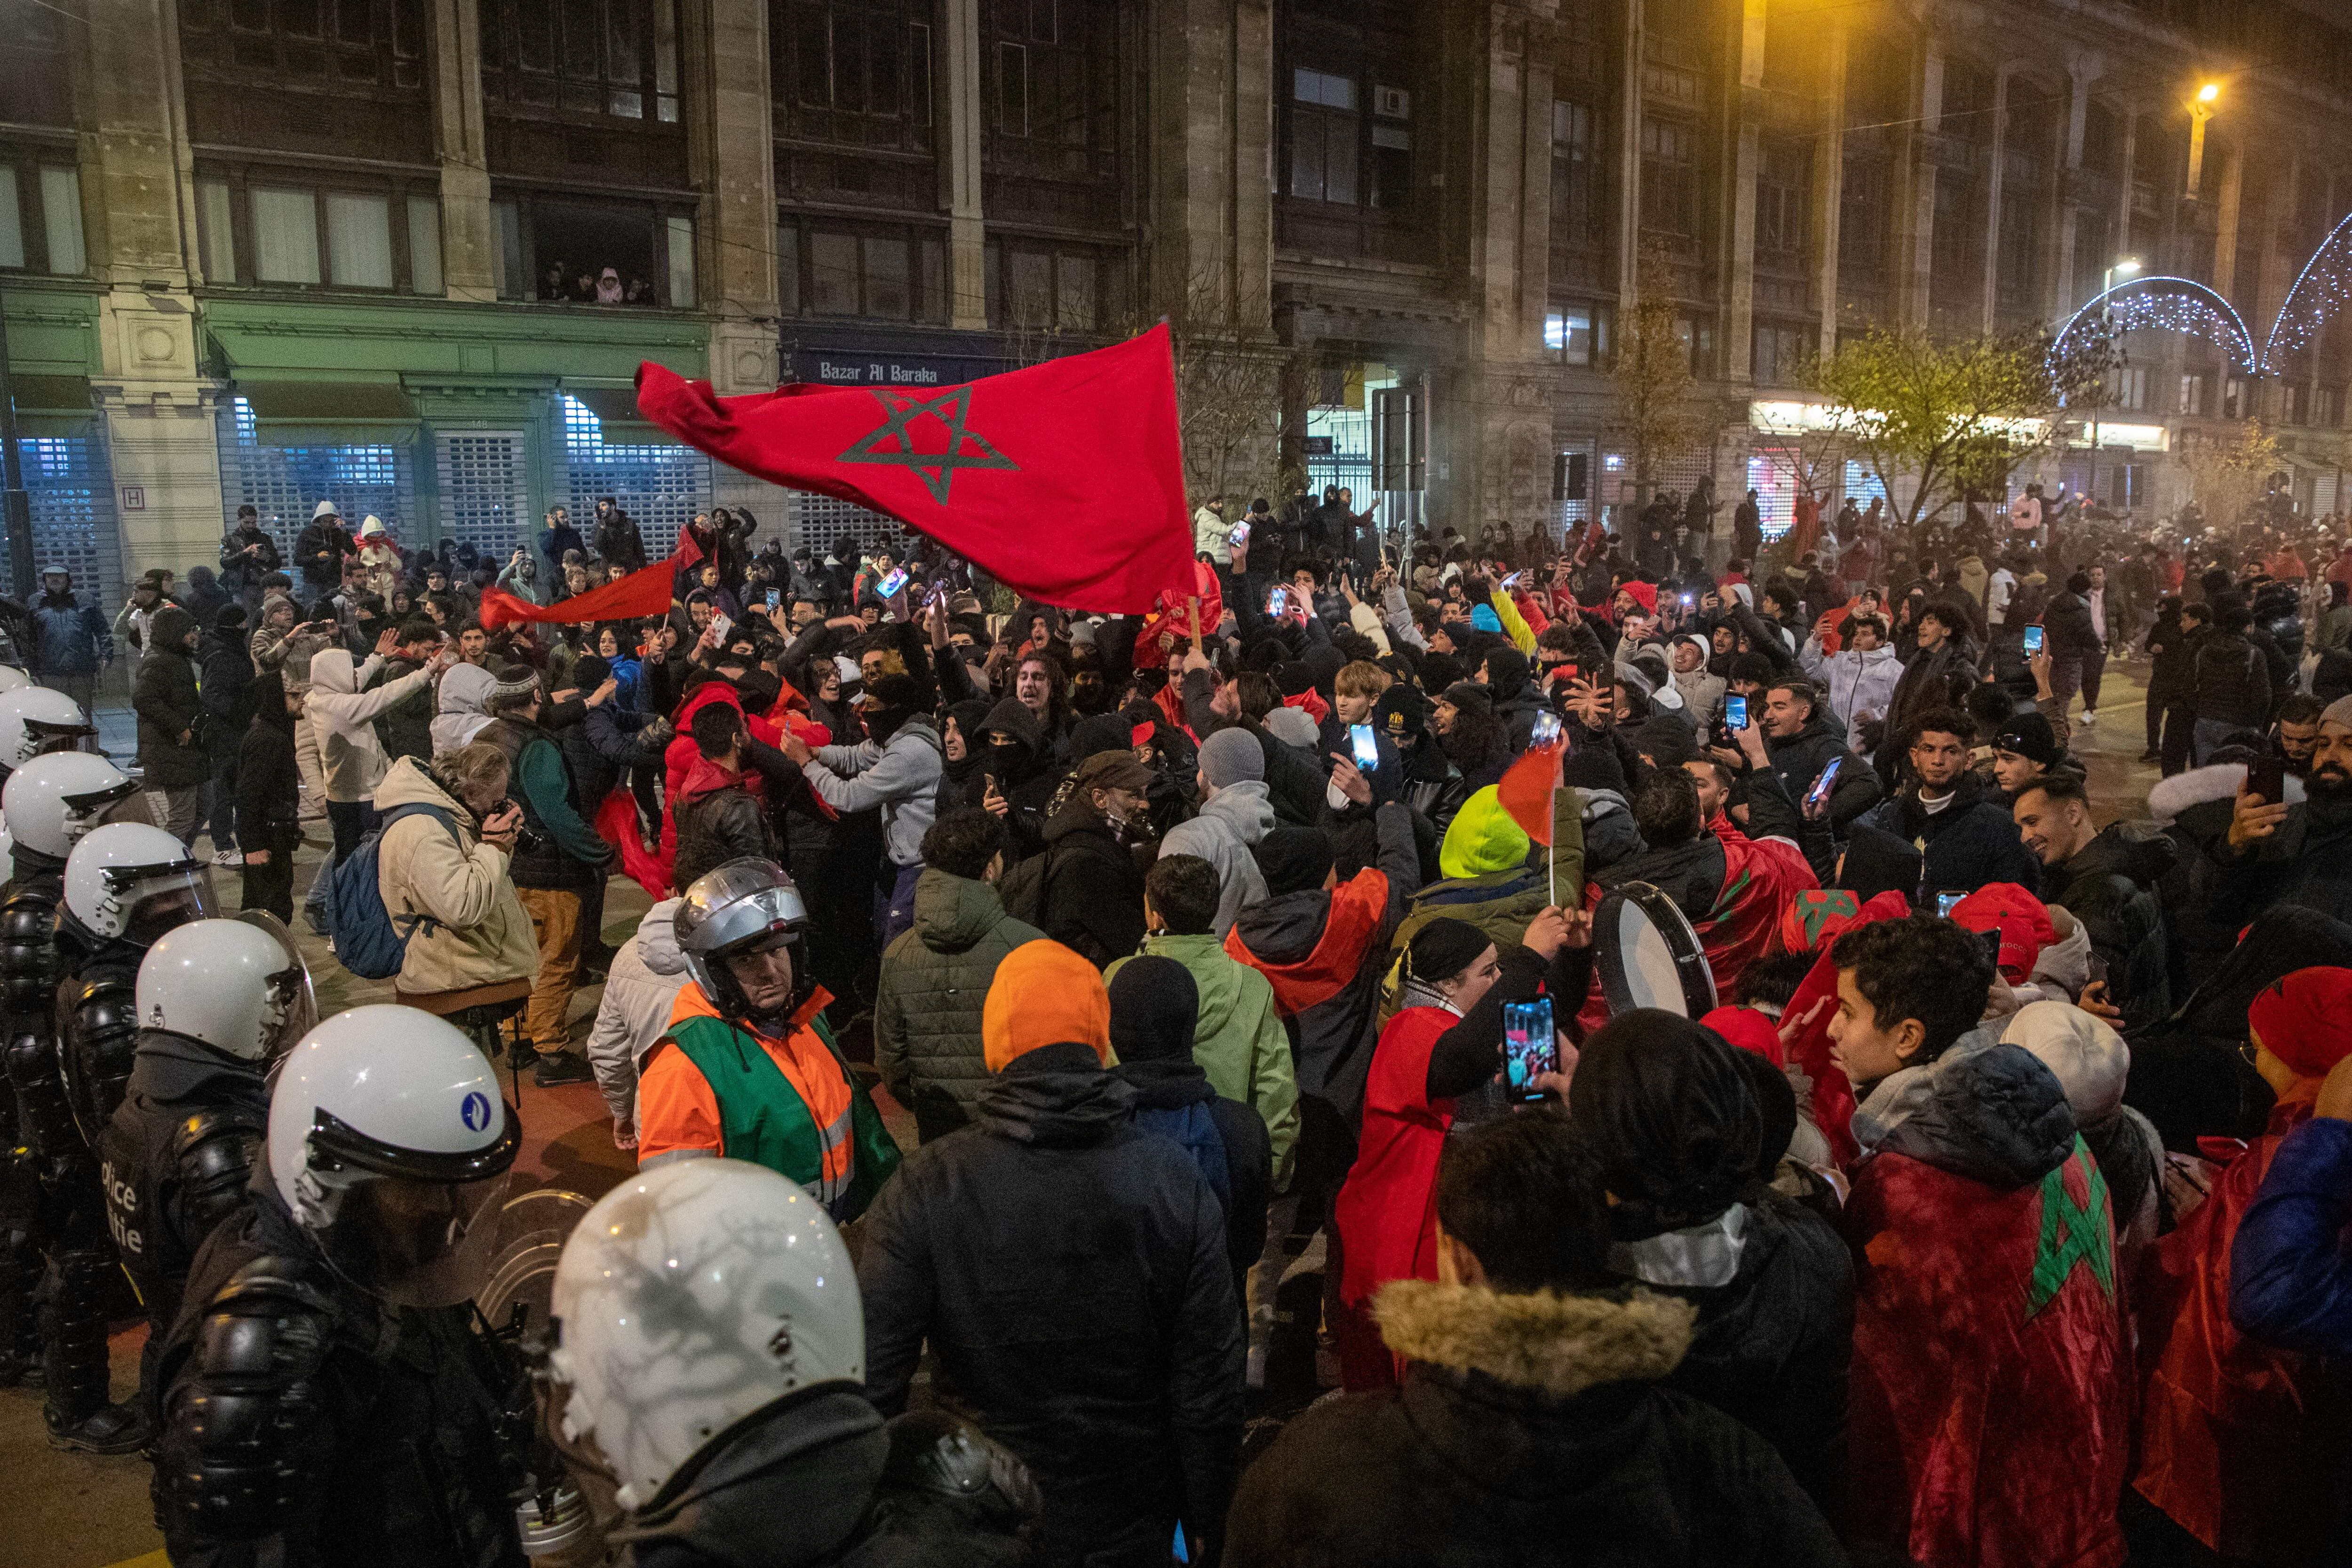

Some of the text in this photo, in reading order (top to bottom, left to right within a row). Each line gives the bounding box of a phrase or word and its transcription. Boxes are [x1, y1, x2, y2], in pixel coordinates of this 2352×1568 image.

[820, 362, 938, 383] Bazar Al Baraka
[128, 491, 140, 505] H
[101, 1160, 137, 1212] olice
